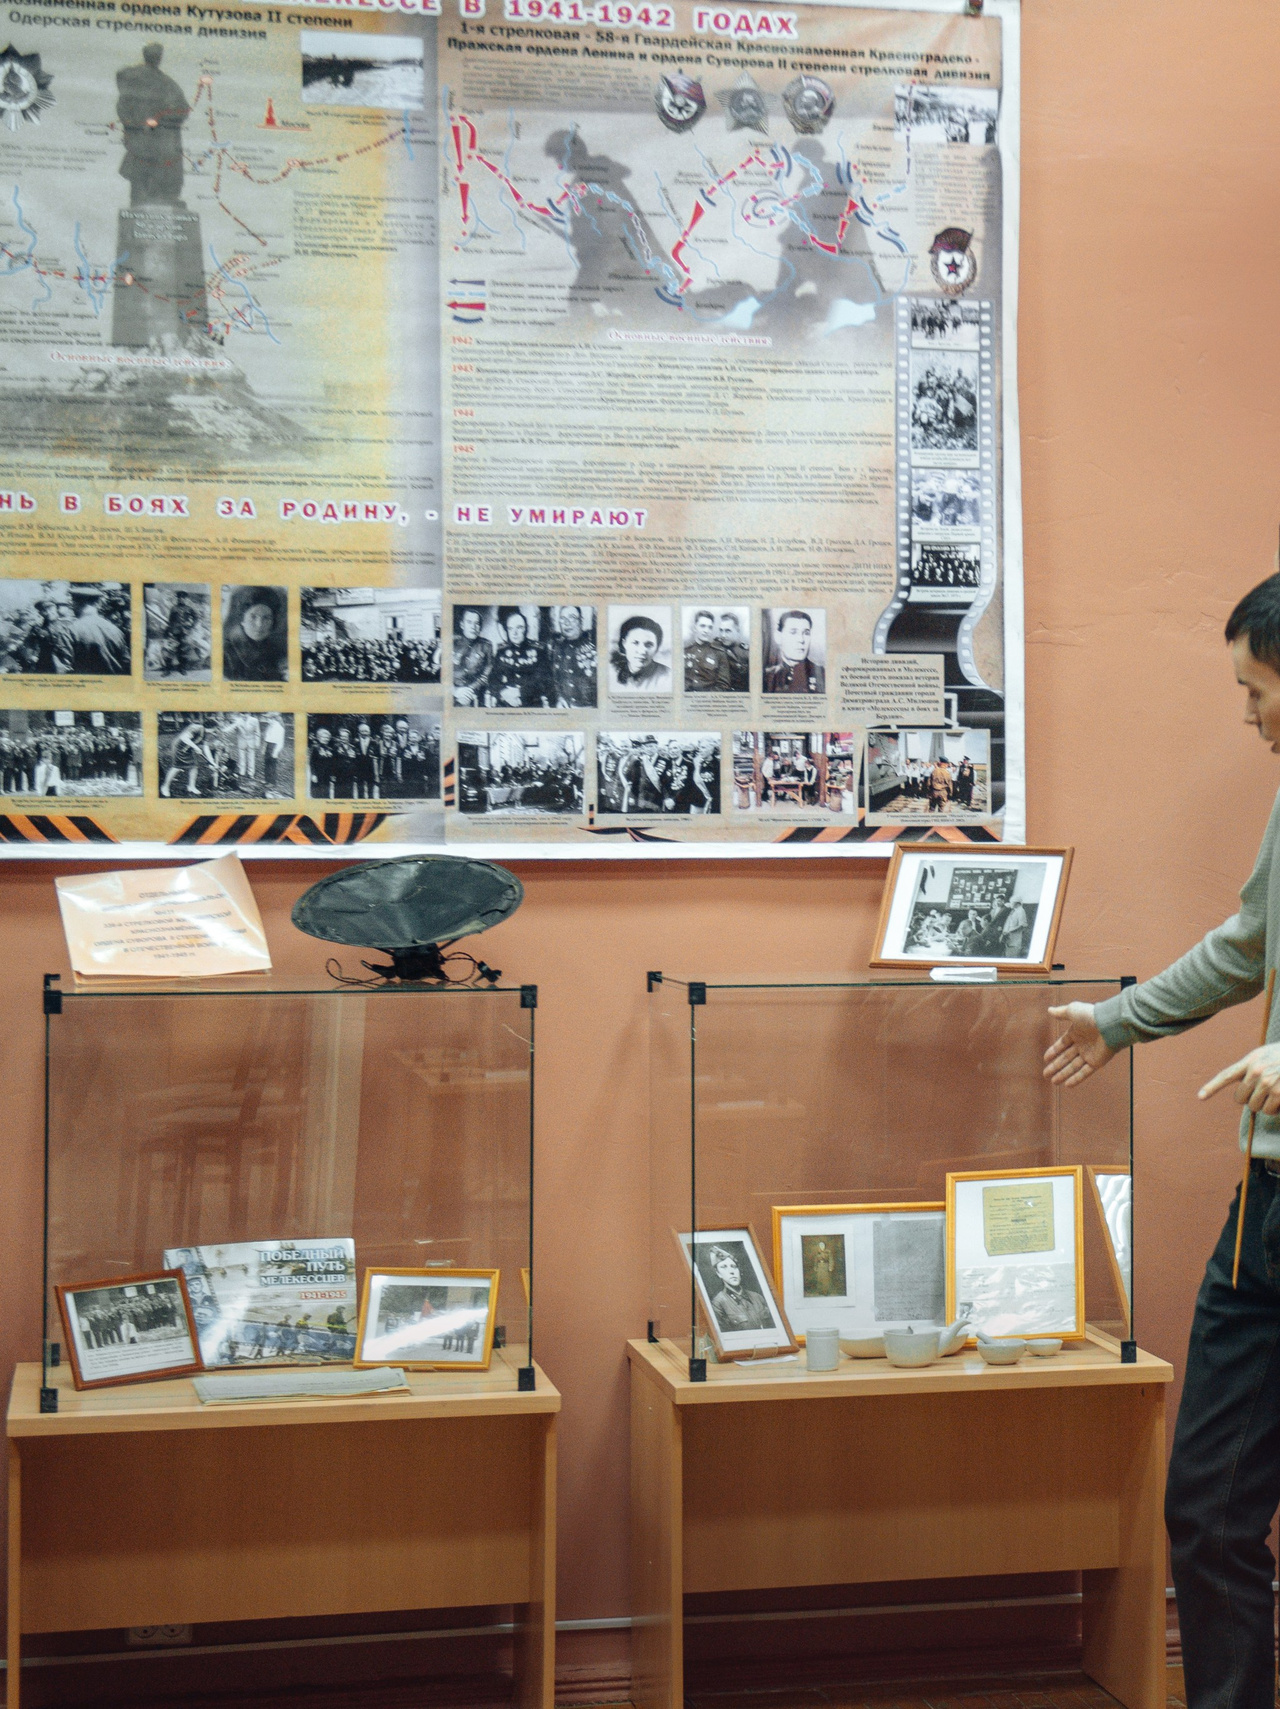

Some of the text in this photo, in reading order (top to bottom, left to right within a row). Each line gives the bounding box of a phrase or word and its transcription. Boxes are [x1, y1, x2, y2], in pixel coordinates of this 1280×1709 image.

[8, 10, 267, 40] Одерская стрелковая дивизия
[121, 4, 182, 17] ордена
[187, 6, 261, 22] Кутузова
[268, 11, 282, 22] II
[288, 14, 353, 28] степени
[509, 0, 671, 27] 1941-1942
[698, 11, 793, 35] ГОДАХ
[460, 21, 485, 35] 1-я
[490, 25, 580, 41] стрелковая
[595, 31, 630, 45] 58-я
[635, 33, 731, 50] Гвардейская
[737, 41, 866, 59] Краснознаменная
[447, 37, 522, 54] Пражская
[527, 46, 578, 58] ордена
[582, 46, 635, 60] Ленина
[651, 53, 702, 65] ордена
[706, 54, 774, 69] Суворова
[790, 61, 846, 74] степени
[851, 64, 928, 78] стрелковая
[934, 69, 990, 81] дивизия
[65, 496, 78, 511] В
[108, 497, 186, 514] БОЯХ
[220, 501, 253, 516] ЗА
[457, 507, 490, 522] НЕ
[511, 509, 646, 526] УМИРАЮТ
[260, 1245, 346, 1262] ПОБЕДНЫЙ
[306, 1261, 346, 1272] ПУТЬ
[260, 1273, 346, 1286] МЕЛЕКЕССЦЕВ
